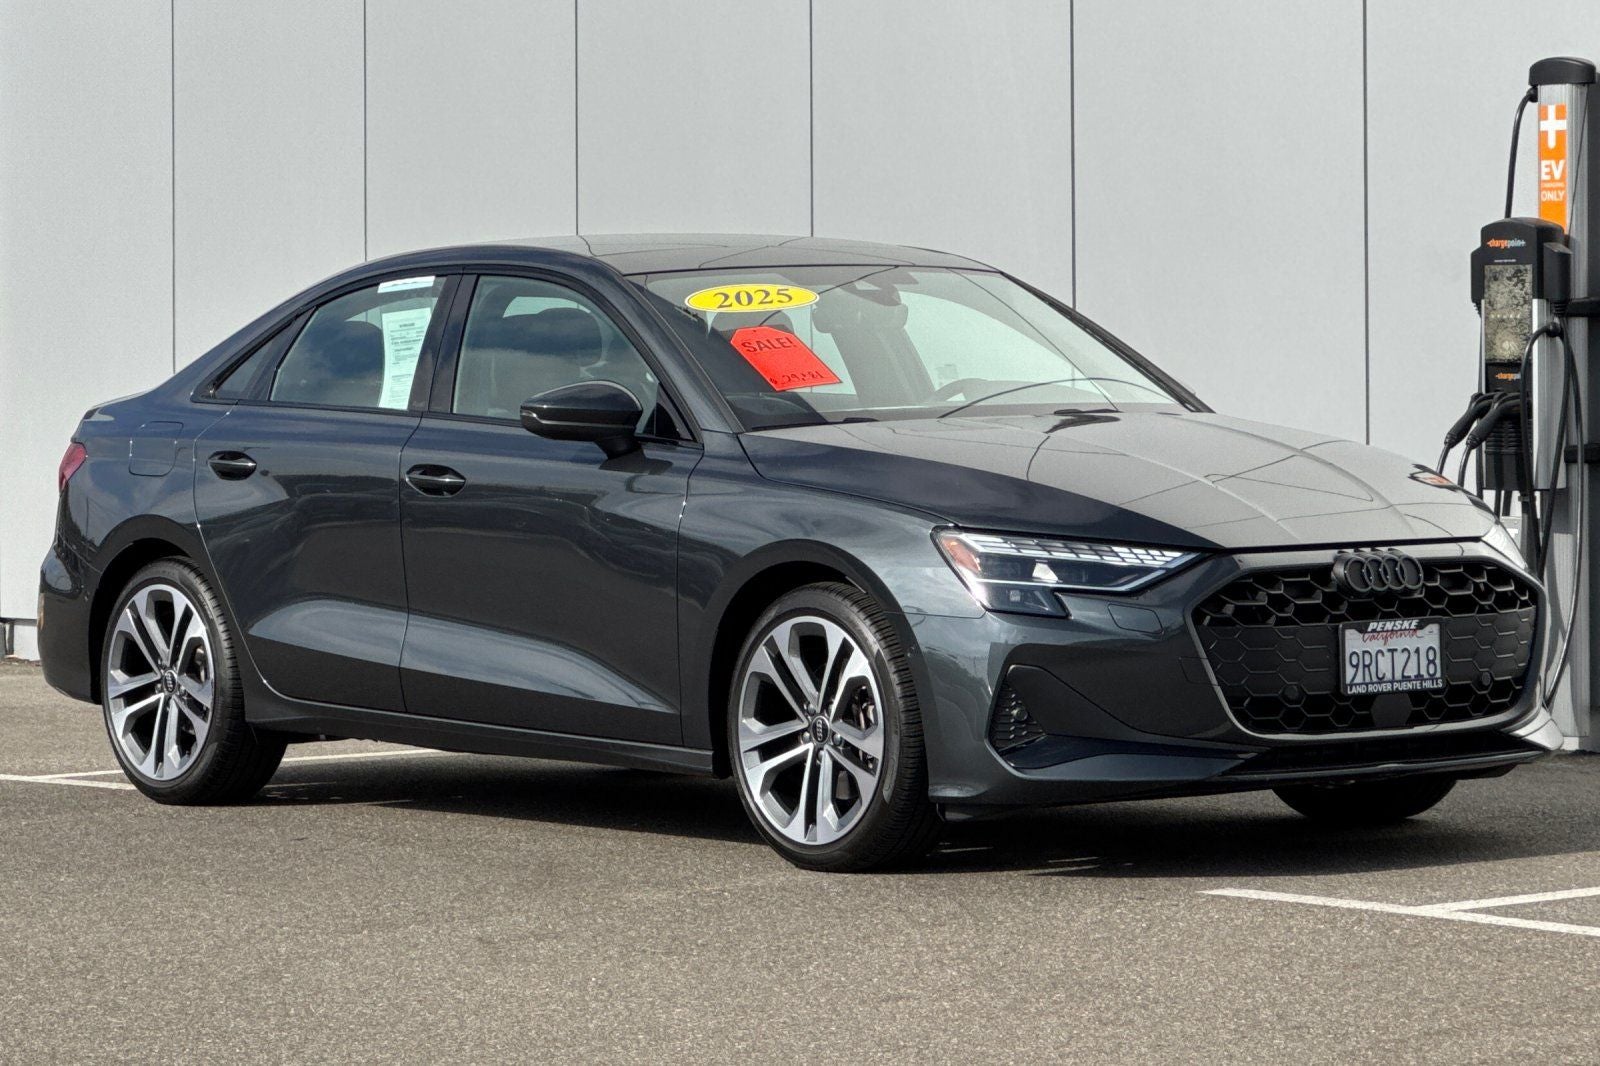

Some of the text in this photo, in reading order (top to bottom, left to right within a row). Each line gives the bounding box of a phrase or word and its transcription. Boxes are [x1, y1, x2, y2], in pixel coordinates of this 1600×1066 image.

[1541, 160, 1566, 180] EV
[1541, 190, 1565, 202] ONLY
[713, 288, 793, 309] 2025
[741, 337, 797, 353] SALE!
[1367, 619, 1419, 632] PENSKE
[1349, 646, 1437, 684] 9RCT218
[1347, 678, 1443, 695] LAND ROVER PUENTE HILLS
